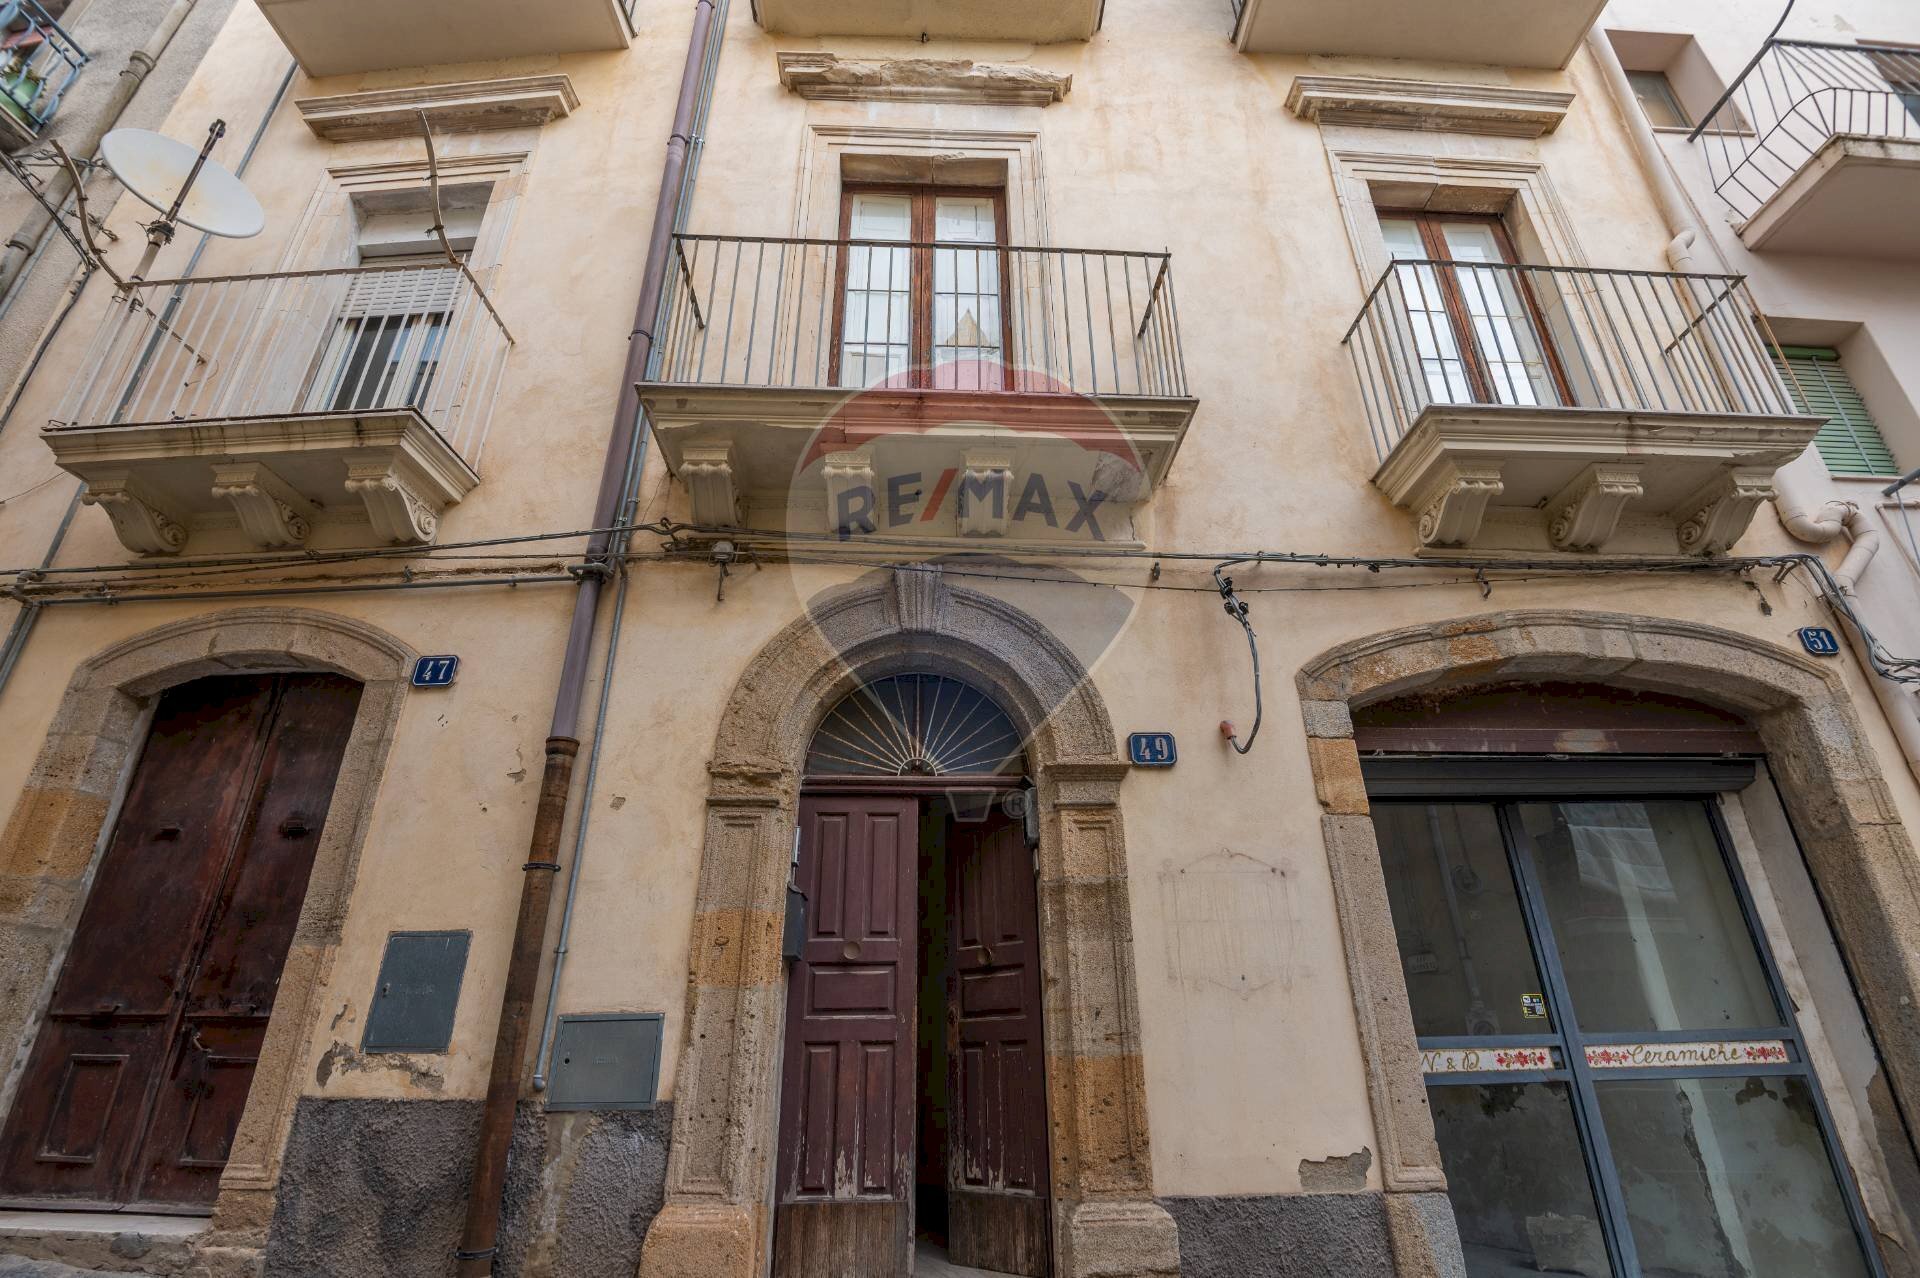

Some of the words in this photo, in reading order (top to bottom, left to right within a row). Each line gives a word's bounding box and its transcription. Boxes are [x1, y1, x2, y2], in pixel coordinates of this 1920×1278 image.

[1807, 631, 1833, 650] 51
[422, 660, 450, 680] 47
[1139, 737, 1169, 760] 49
[1446, 1057, 1457, 1070] &
[1626, 1042, 1743, 1064] Ceramiche
